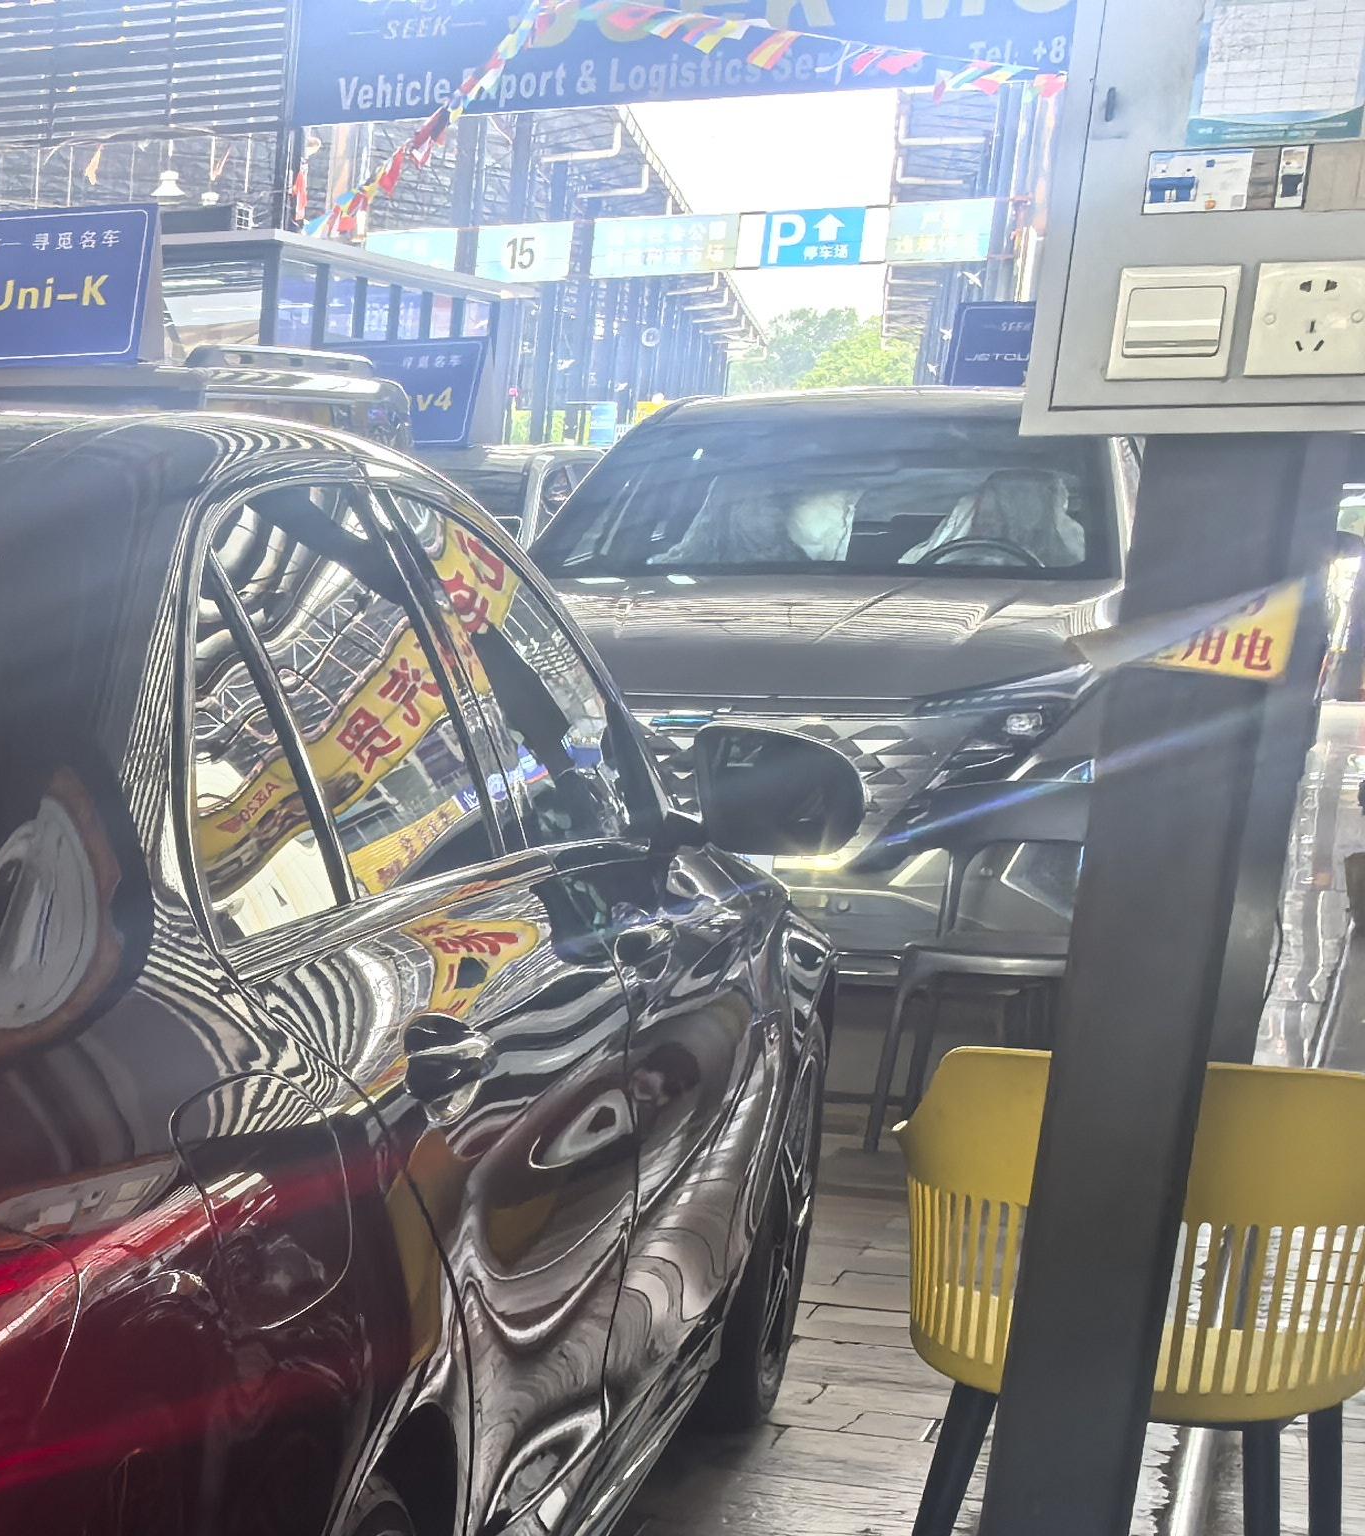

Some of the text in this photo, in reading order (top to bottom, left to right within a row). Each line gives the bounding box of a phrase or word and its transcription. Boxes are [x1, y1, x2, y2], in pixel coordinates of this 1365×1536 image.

[382, 15, 452, 40] SEEK
[337, 70, 450, 111] Vehicle
[575, 58, 598, 95] &
[609, 51, 763, 97] Logistics
[31, 228, 122, 251] 寻觅名车
[506, 235, 536, 270] 15
[767, 213, 806, 265] P
[803, 243, 850, 261] 停车场
